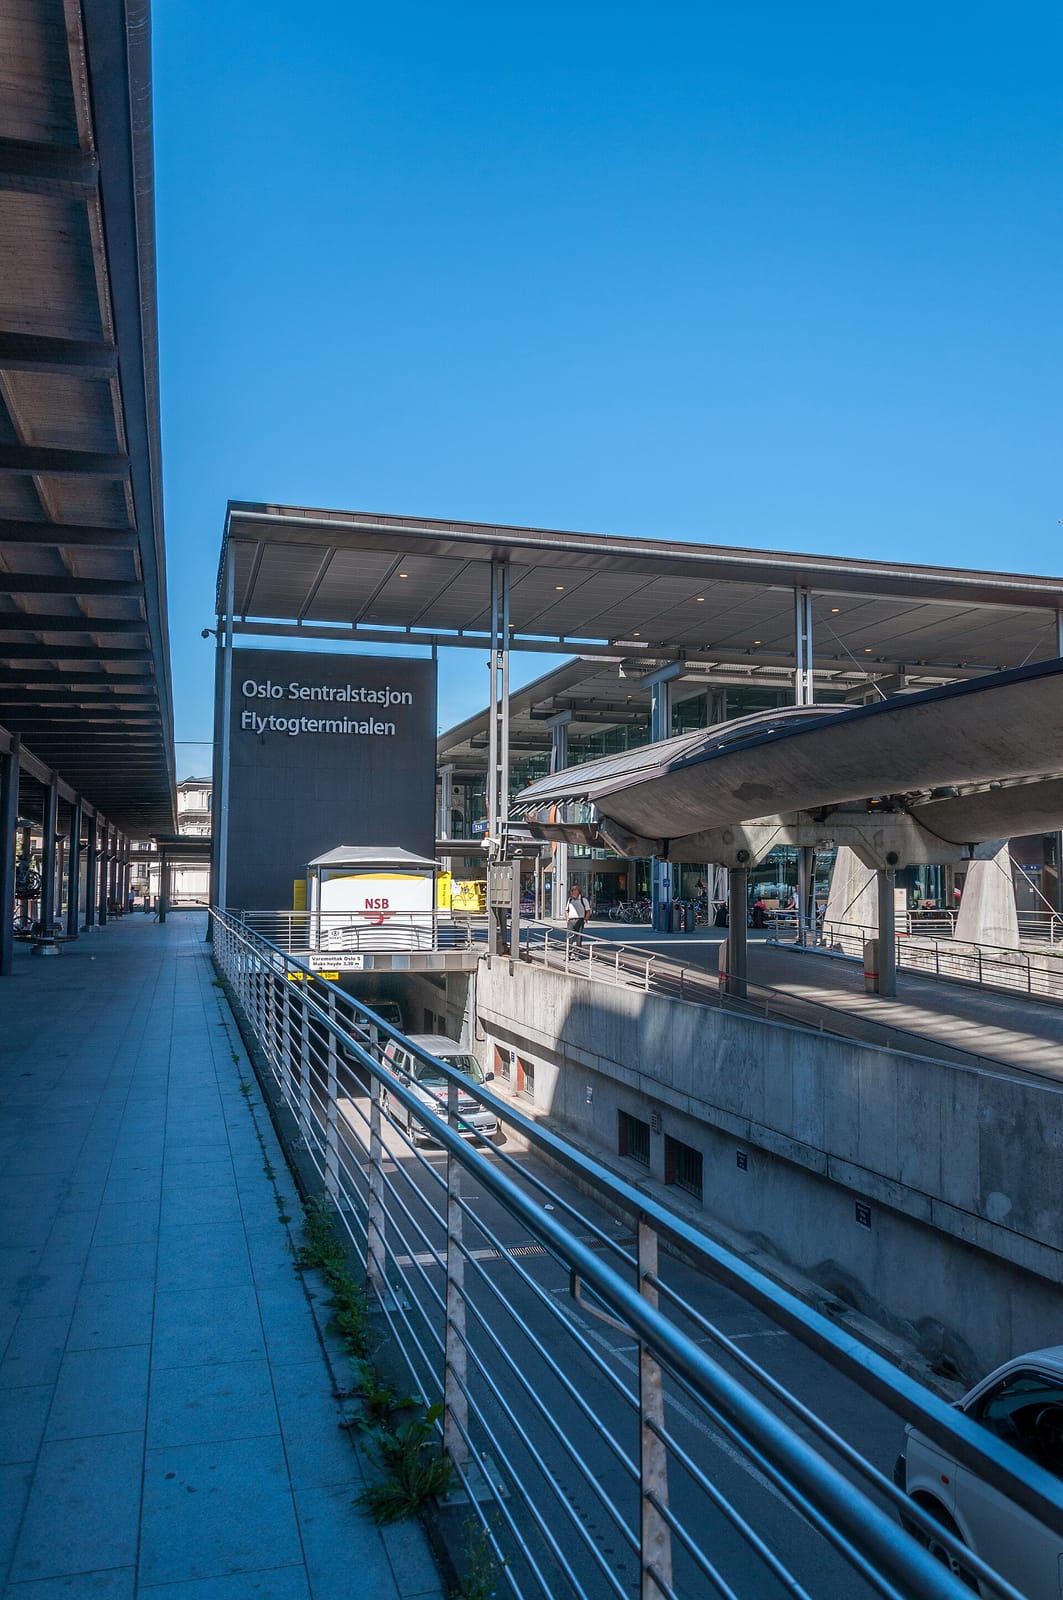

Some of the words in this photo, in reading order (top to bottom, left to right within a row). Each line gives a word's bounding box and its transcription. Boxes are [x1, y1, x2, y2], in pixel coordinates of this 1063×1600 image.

[242, 680, 283, 698] Oslo
[288, 682, 413, 708] Sentralstasjon
[241, 711, 396, 736] Flytogterminalen
[364, 898, 389, 910] NSB
